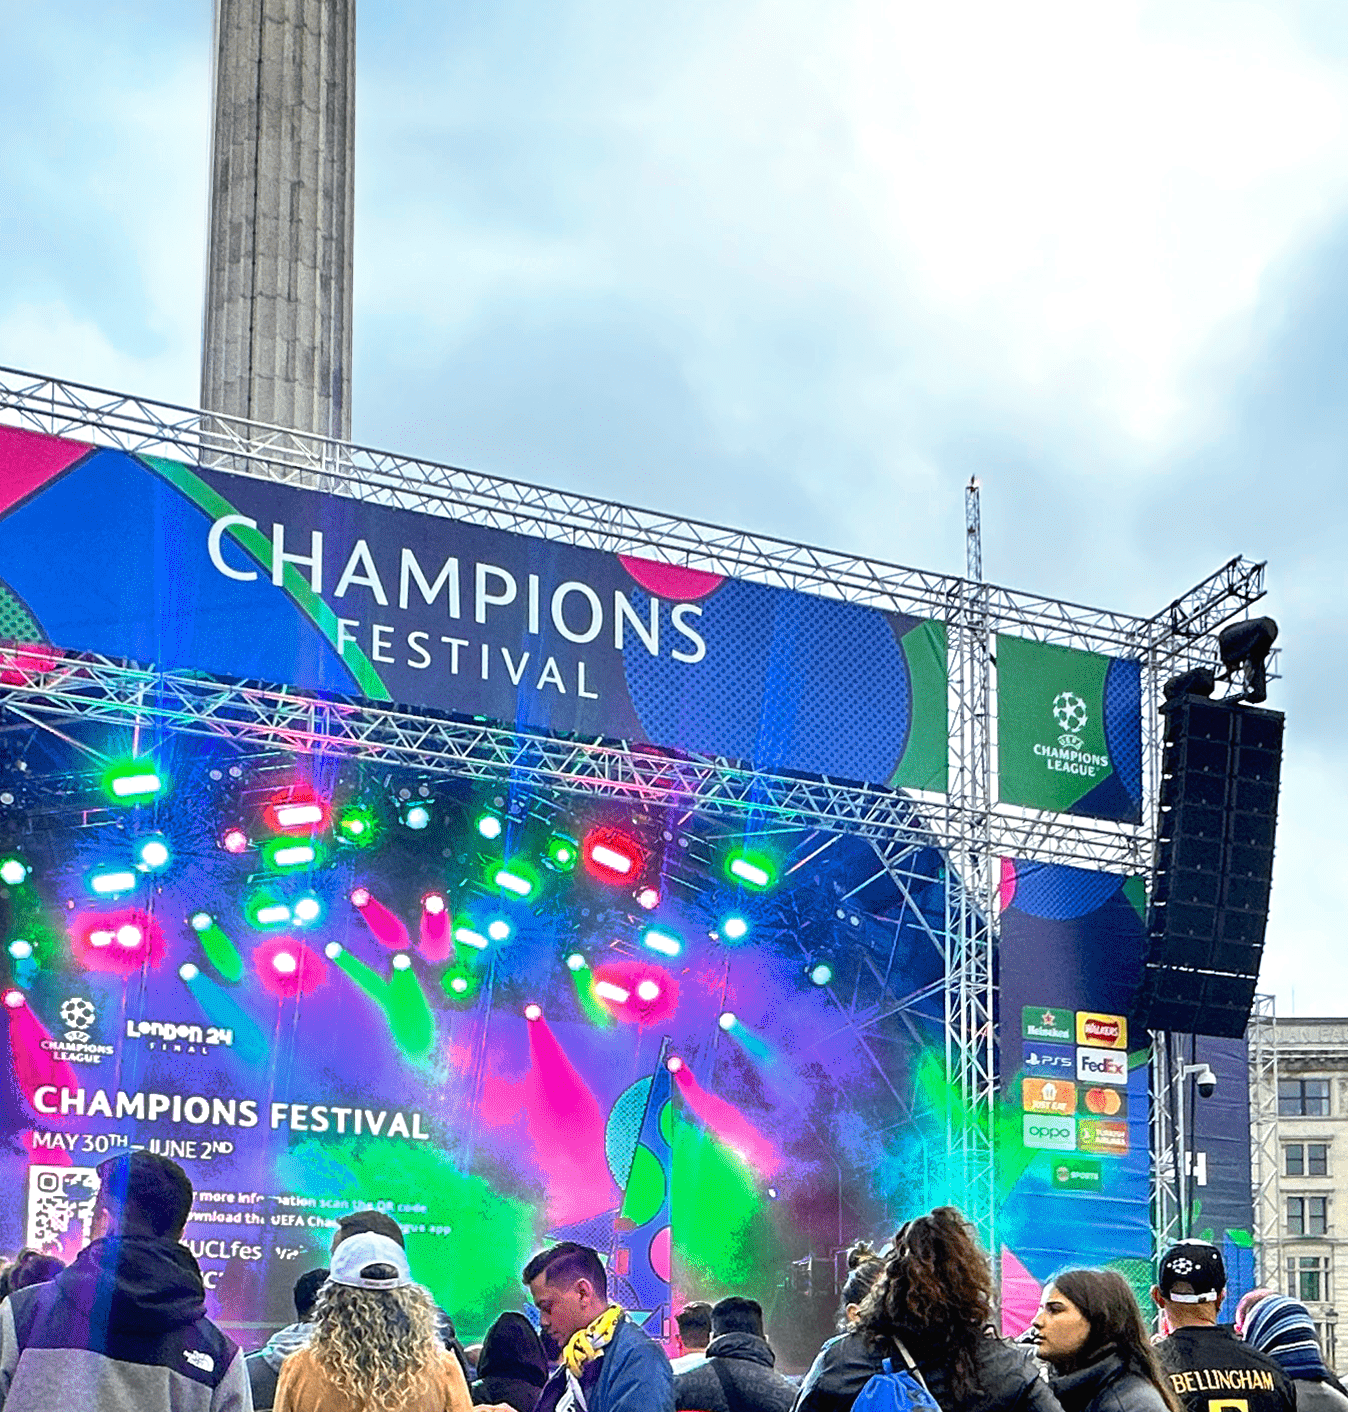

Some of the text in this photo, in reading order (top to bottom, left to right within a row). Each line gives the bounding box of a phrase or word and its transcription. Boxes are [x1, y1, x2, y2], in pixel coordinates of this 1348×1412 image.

[207, 513, 707, 663] CHAMPIONS
[337, 619, 598, 699] FESTIVAL
[1058, 736, 1084, 750] UEFA
[1033, 744, 1109, 767] CHAMPIONS
[1047, 759, 1096, 777] LEAGUE
[206, 1028, 234, 1046] 24
[1027, 1025, 1070, 1039] Heineken
[40, 1040, 114, 1056] CHAMPIONS
[149, 1043, 208, 1055] FINAL
[53, 1051, 102, 1064] LEAGUE
[1041, 1055, 1072, 1067] PS5
[1081, 1056, 1124, 1075] FedEx
[33, 1086, 430, 1141] CHAMPIONS FESTIVAL
[31, 1131, 80, 1151] MAY
[83, 1133, 129, 1154] 30TH
[200, 1140, 234, 1160] 2ND
[199, 1192, 235, 1203] more
[270, 1214, 305, 1226] UEFA
[1169, 1368, 1275, 1394] BELLINGHAM
